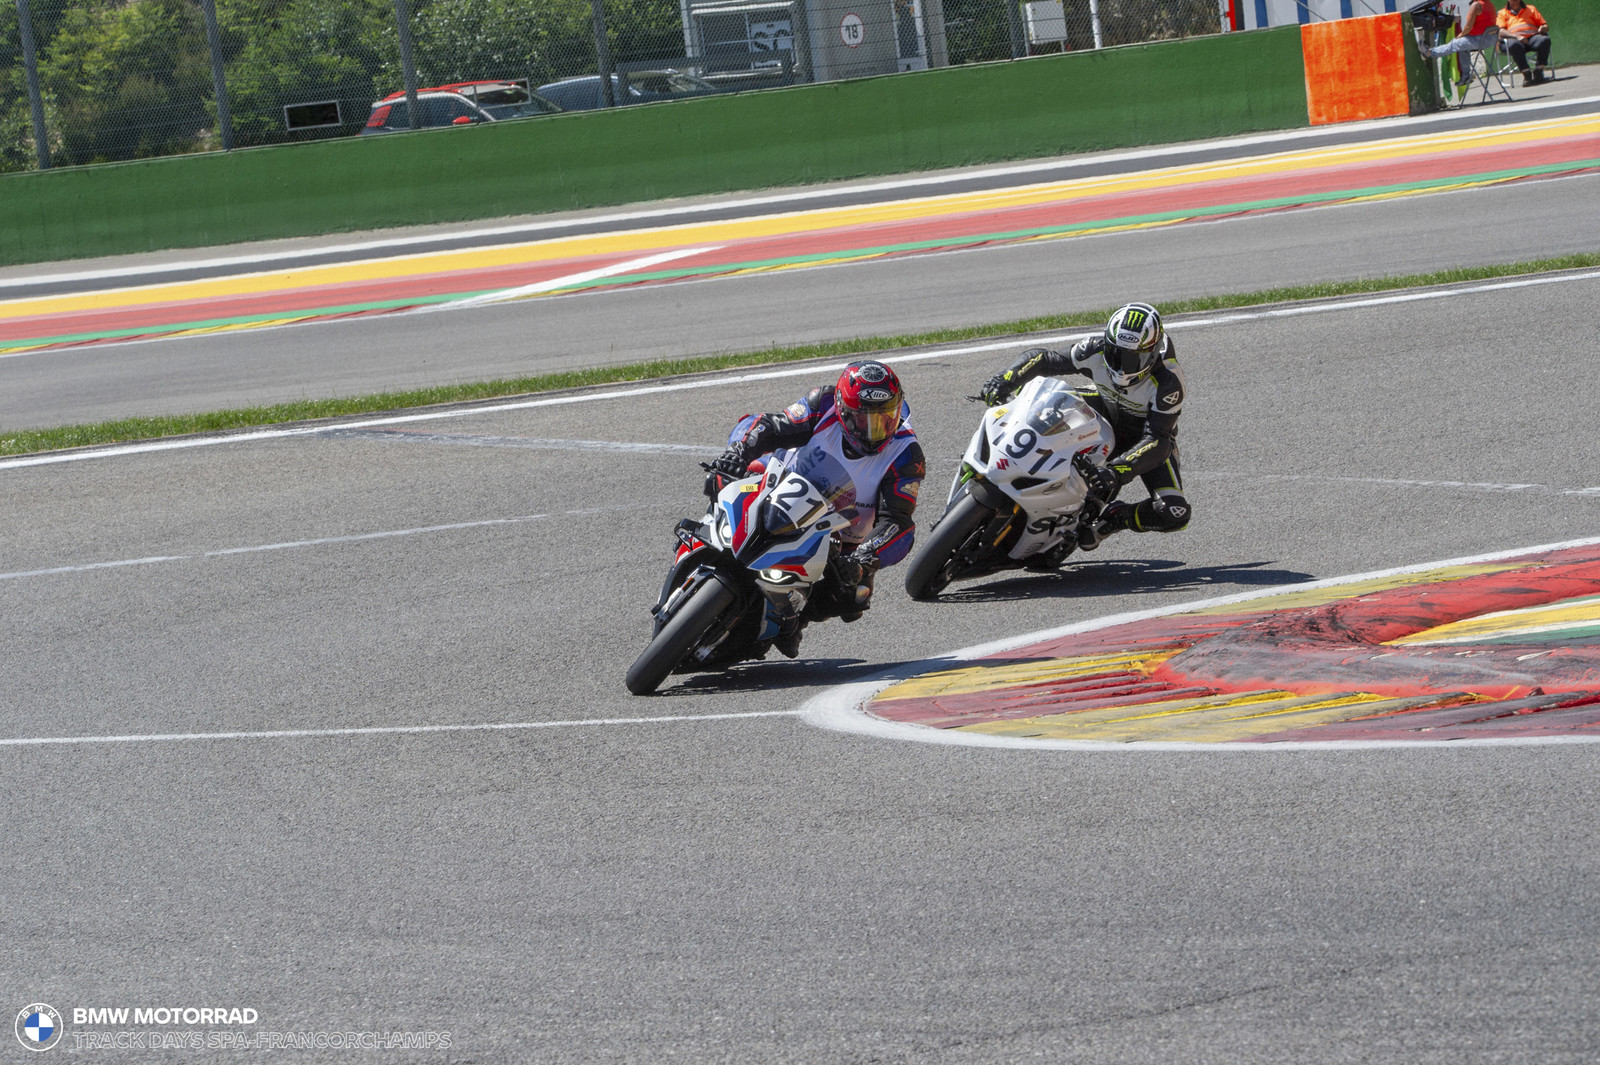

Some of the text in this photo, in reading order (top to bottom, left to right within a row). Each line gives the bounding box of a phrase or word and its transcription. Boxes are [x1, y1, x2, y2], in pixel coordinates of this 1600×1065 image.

[845, 25, 859, 40] 18
[1005, 428, 1054, 476] 91
[775, 477, 825, 525] 21
